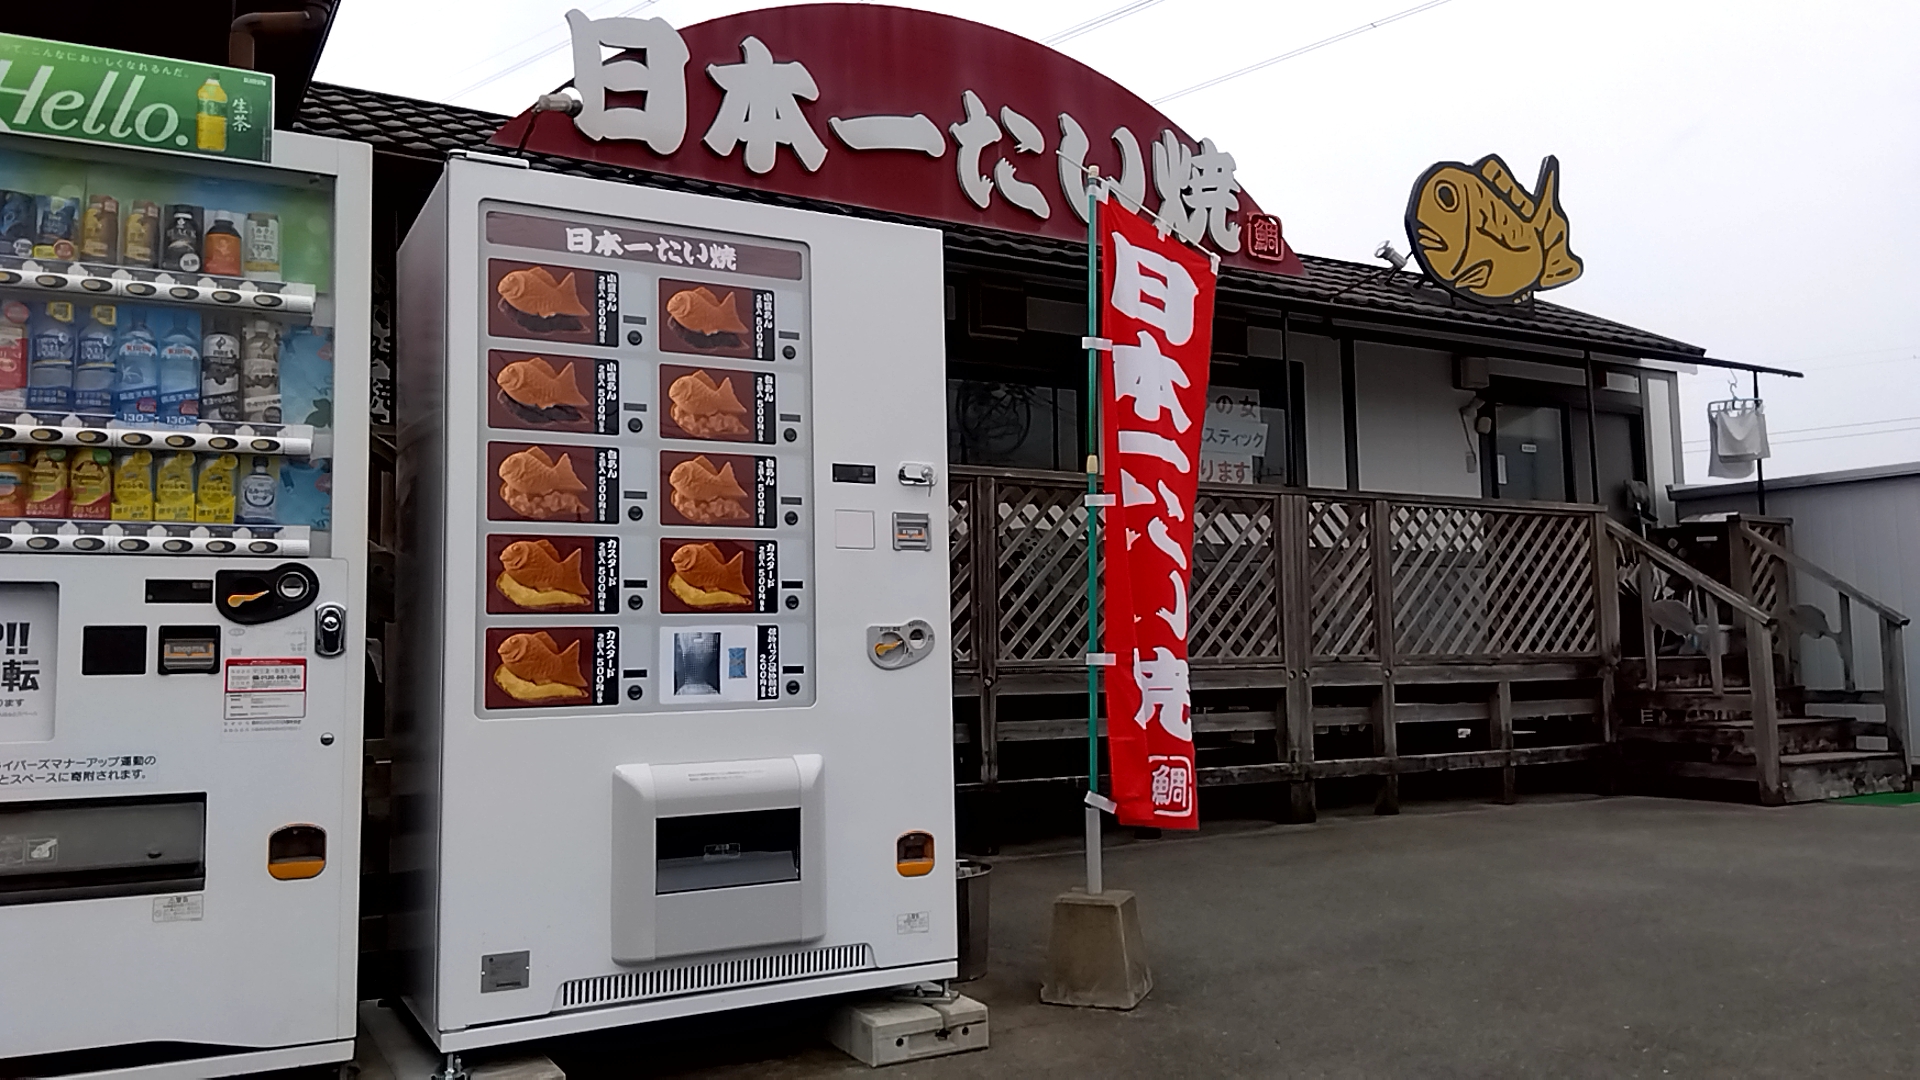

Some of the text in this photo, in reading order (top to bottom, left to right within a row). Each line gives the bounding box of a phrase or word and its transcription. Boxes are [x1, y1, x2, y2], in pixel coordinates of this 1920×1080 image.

[0, 59, 189, 146] Hello.
[231, 97, 252, 132] 生茶
[565, 8, 1242, 253] 日本一たい焼
[565, 227, 738, 271] 日本一たい焼
[607, 539, 617, 587] カスタード
[766, 543, 776, 588] カスタード
[1, 659, 40, 692] 転
[606, 629, 616, 679] カスタード
[1151, 764, 1188, 806] 鯛
